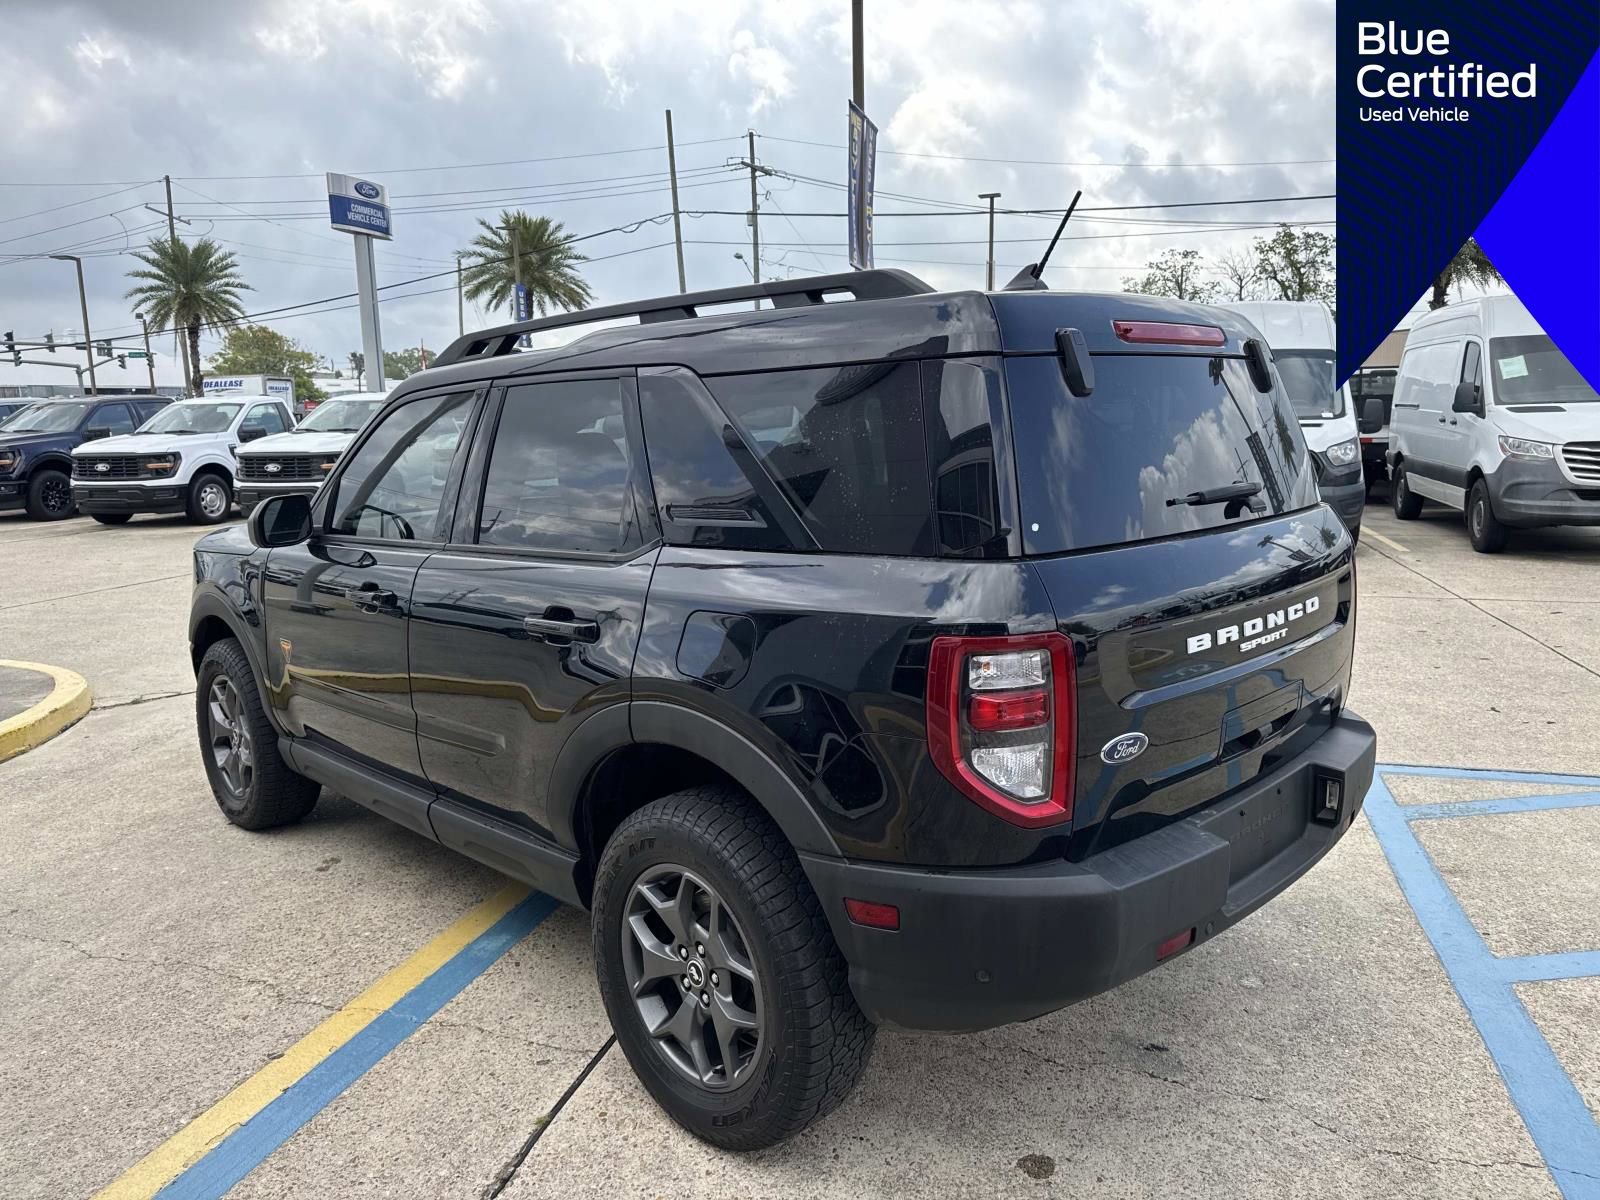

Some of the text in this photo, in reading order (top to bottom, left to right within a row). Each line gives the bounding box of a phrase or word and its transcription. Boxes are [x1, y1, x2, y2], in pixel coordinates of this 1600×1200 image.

[347, 211, 388, 228] VEHICLE CENTER
[350, 203, 384, 219] COMMERCIAL
[1187, 596, 1320, 654] BRONCO
[1239, 627, 1289, 653] SPORT
